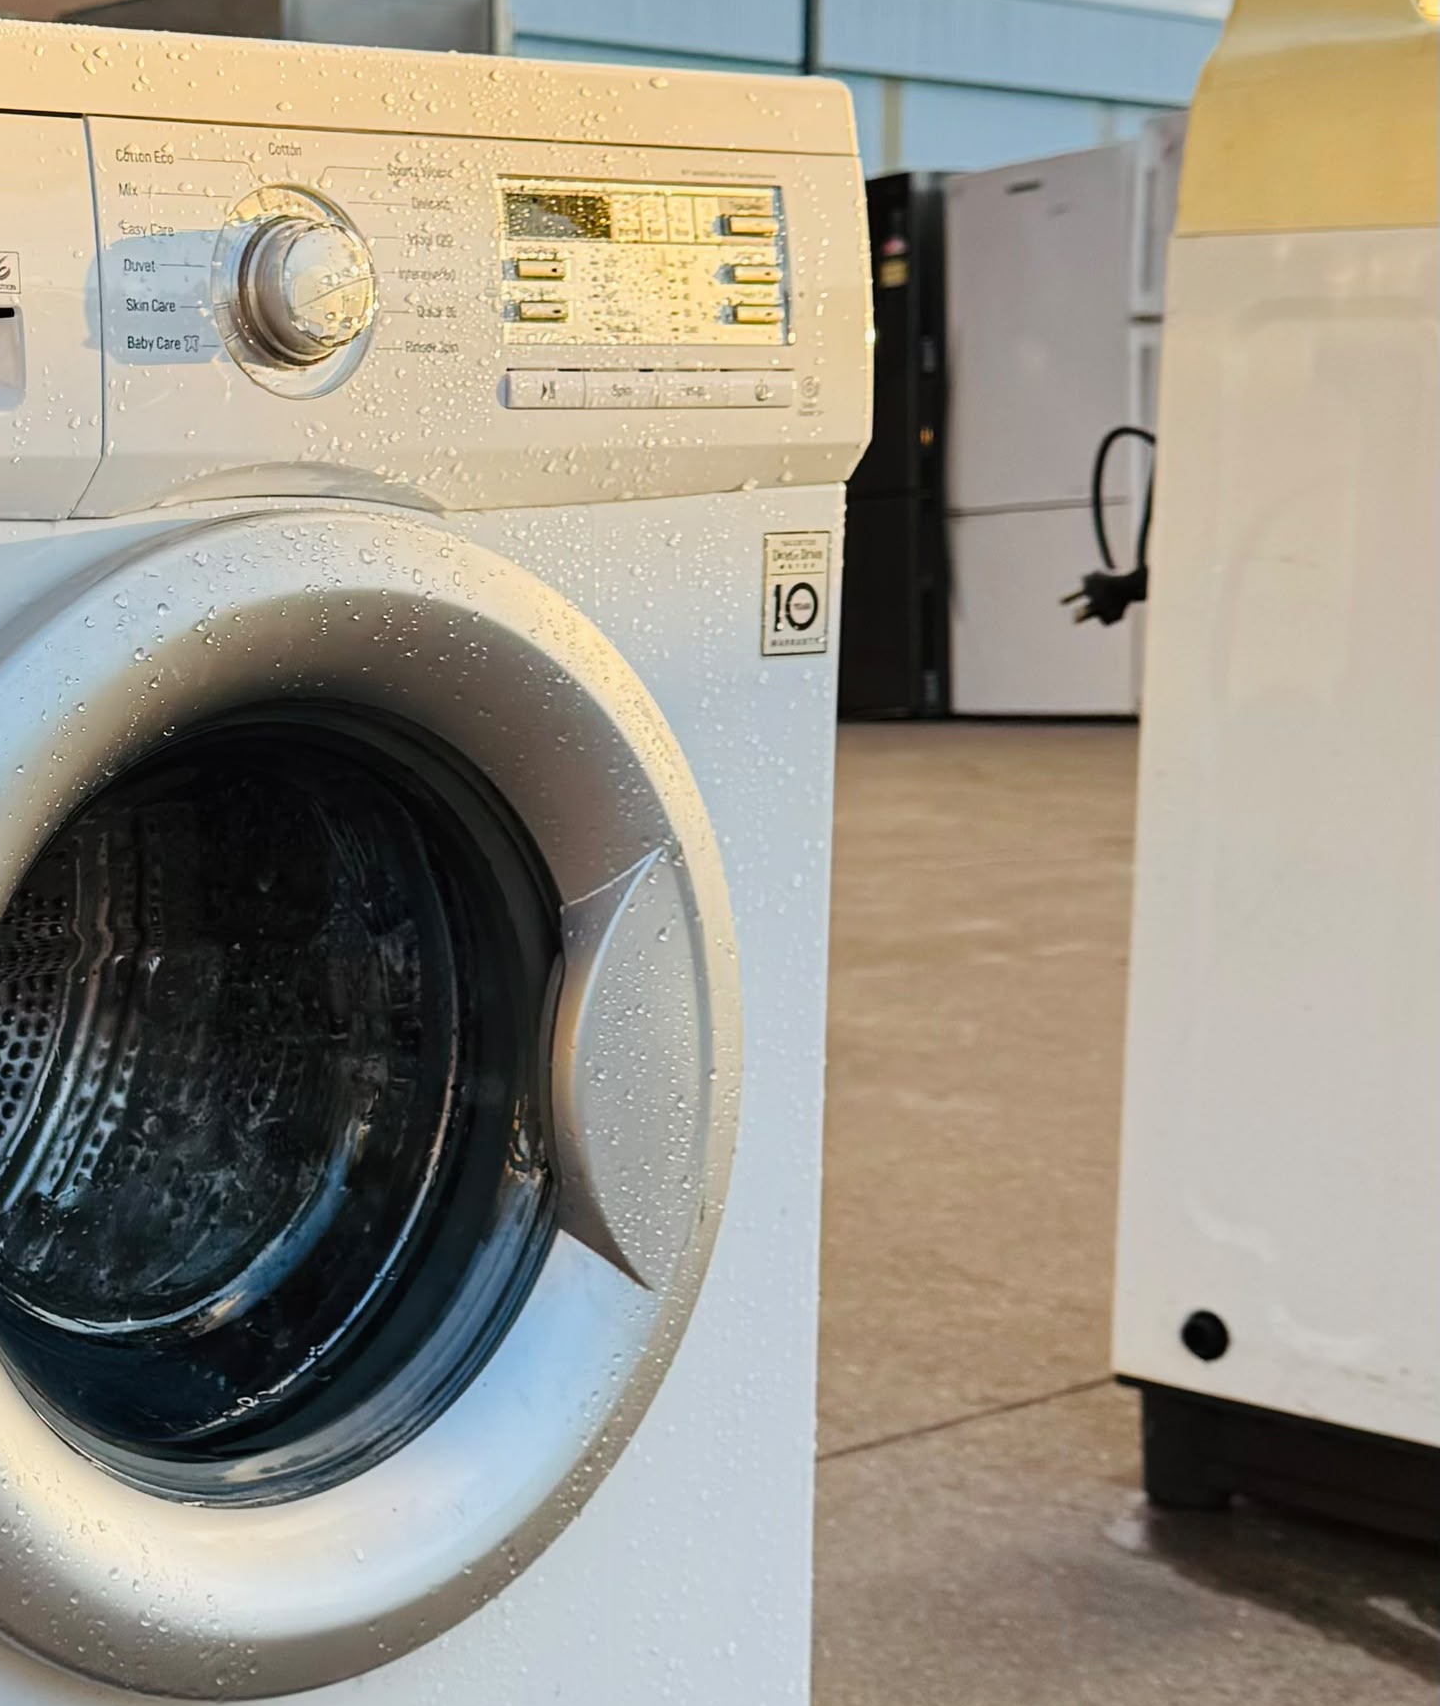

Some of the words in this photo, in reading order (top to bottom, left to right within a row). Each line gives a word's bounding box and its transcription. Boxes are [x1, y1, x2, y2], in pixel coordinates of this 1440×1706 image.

[115, 148, 152, 163] Cotton
[154, 150, 174, 165] Eco
[268, 142, 302, 156] Cotton
[118, 183, 138, 197] Mix
[121, 224, 146, 238] Easy
[150, 224, 174, 237] Care
[123, 258, 156, 273] Duvet
[126, 297, 149, 312] Skin
[151, 298, 176, 313] Care
[127, 335, 154, 353] Baby
[156, 336, 181, 350] Care
